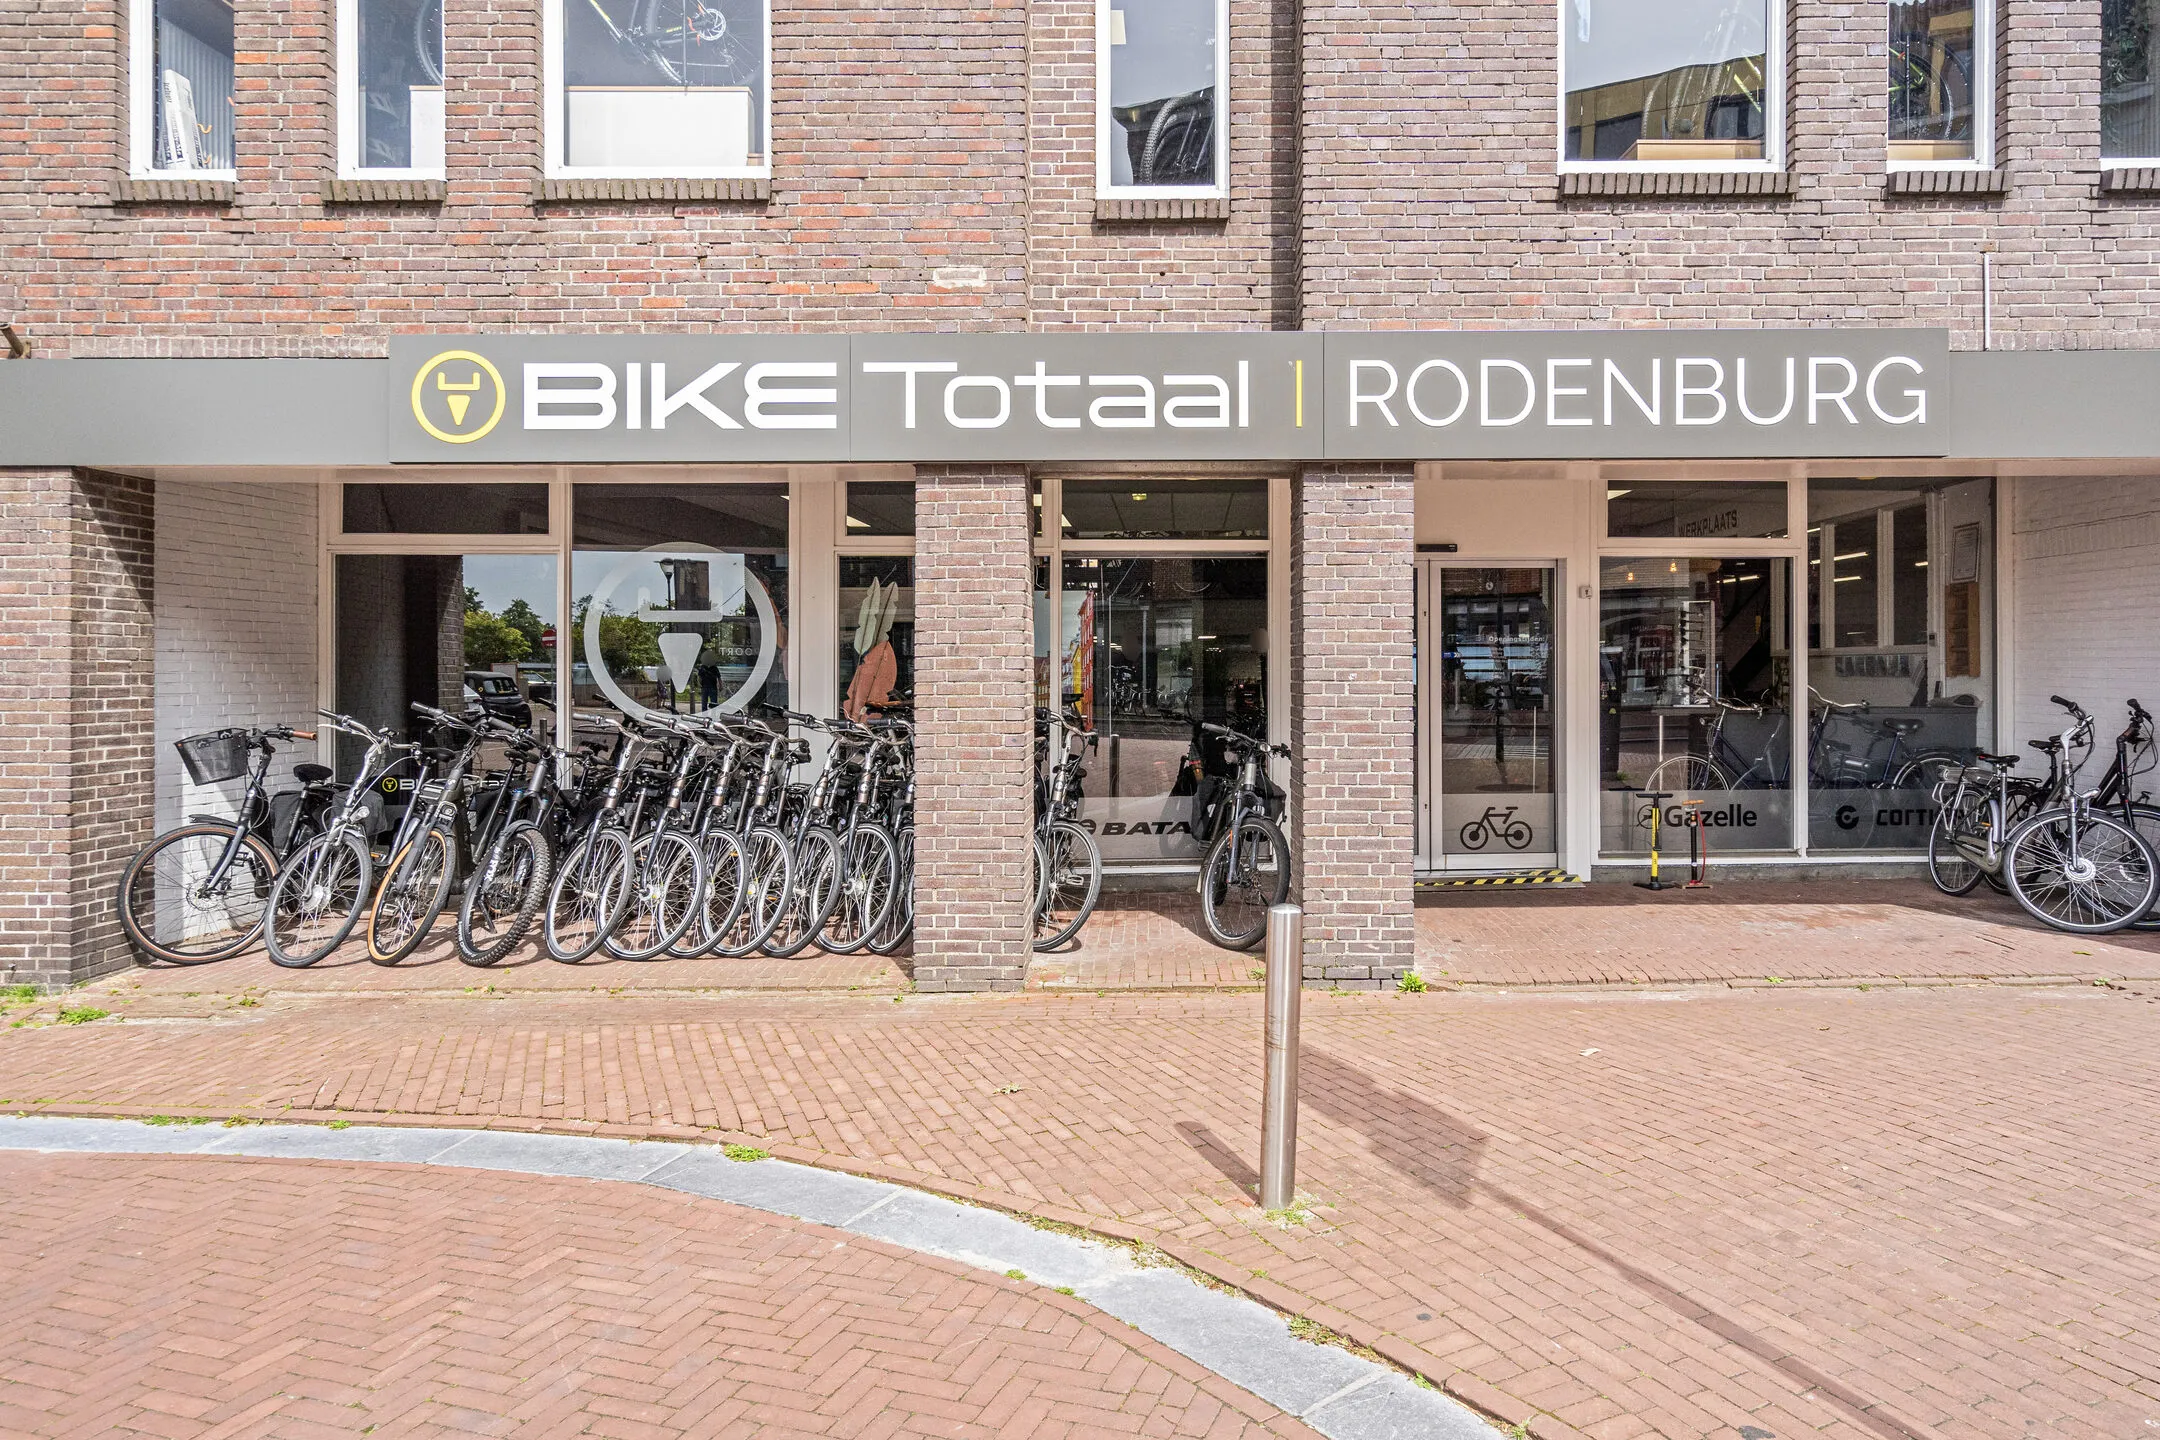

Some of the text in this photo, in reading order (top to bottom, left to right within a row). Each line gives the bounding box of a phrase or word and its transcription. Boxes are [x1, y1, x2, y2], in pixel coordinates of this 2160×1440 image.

[524, 357, 1925, 429] BIKE Totaal RODENBURG
[1678, 509, 1738, 537] WERKPLAATS
[1101, 821, 1194, 836] BATA
